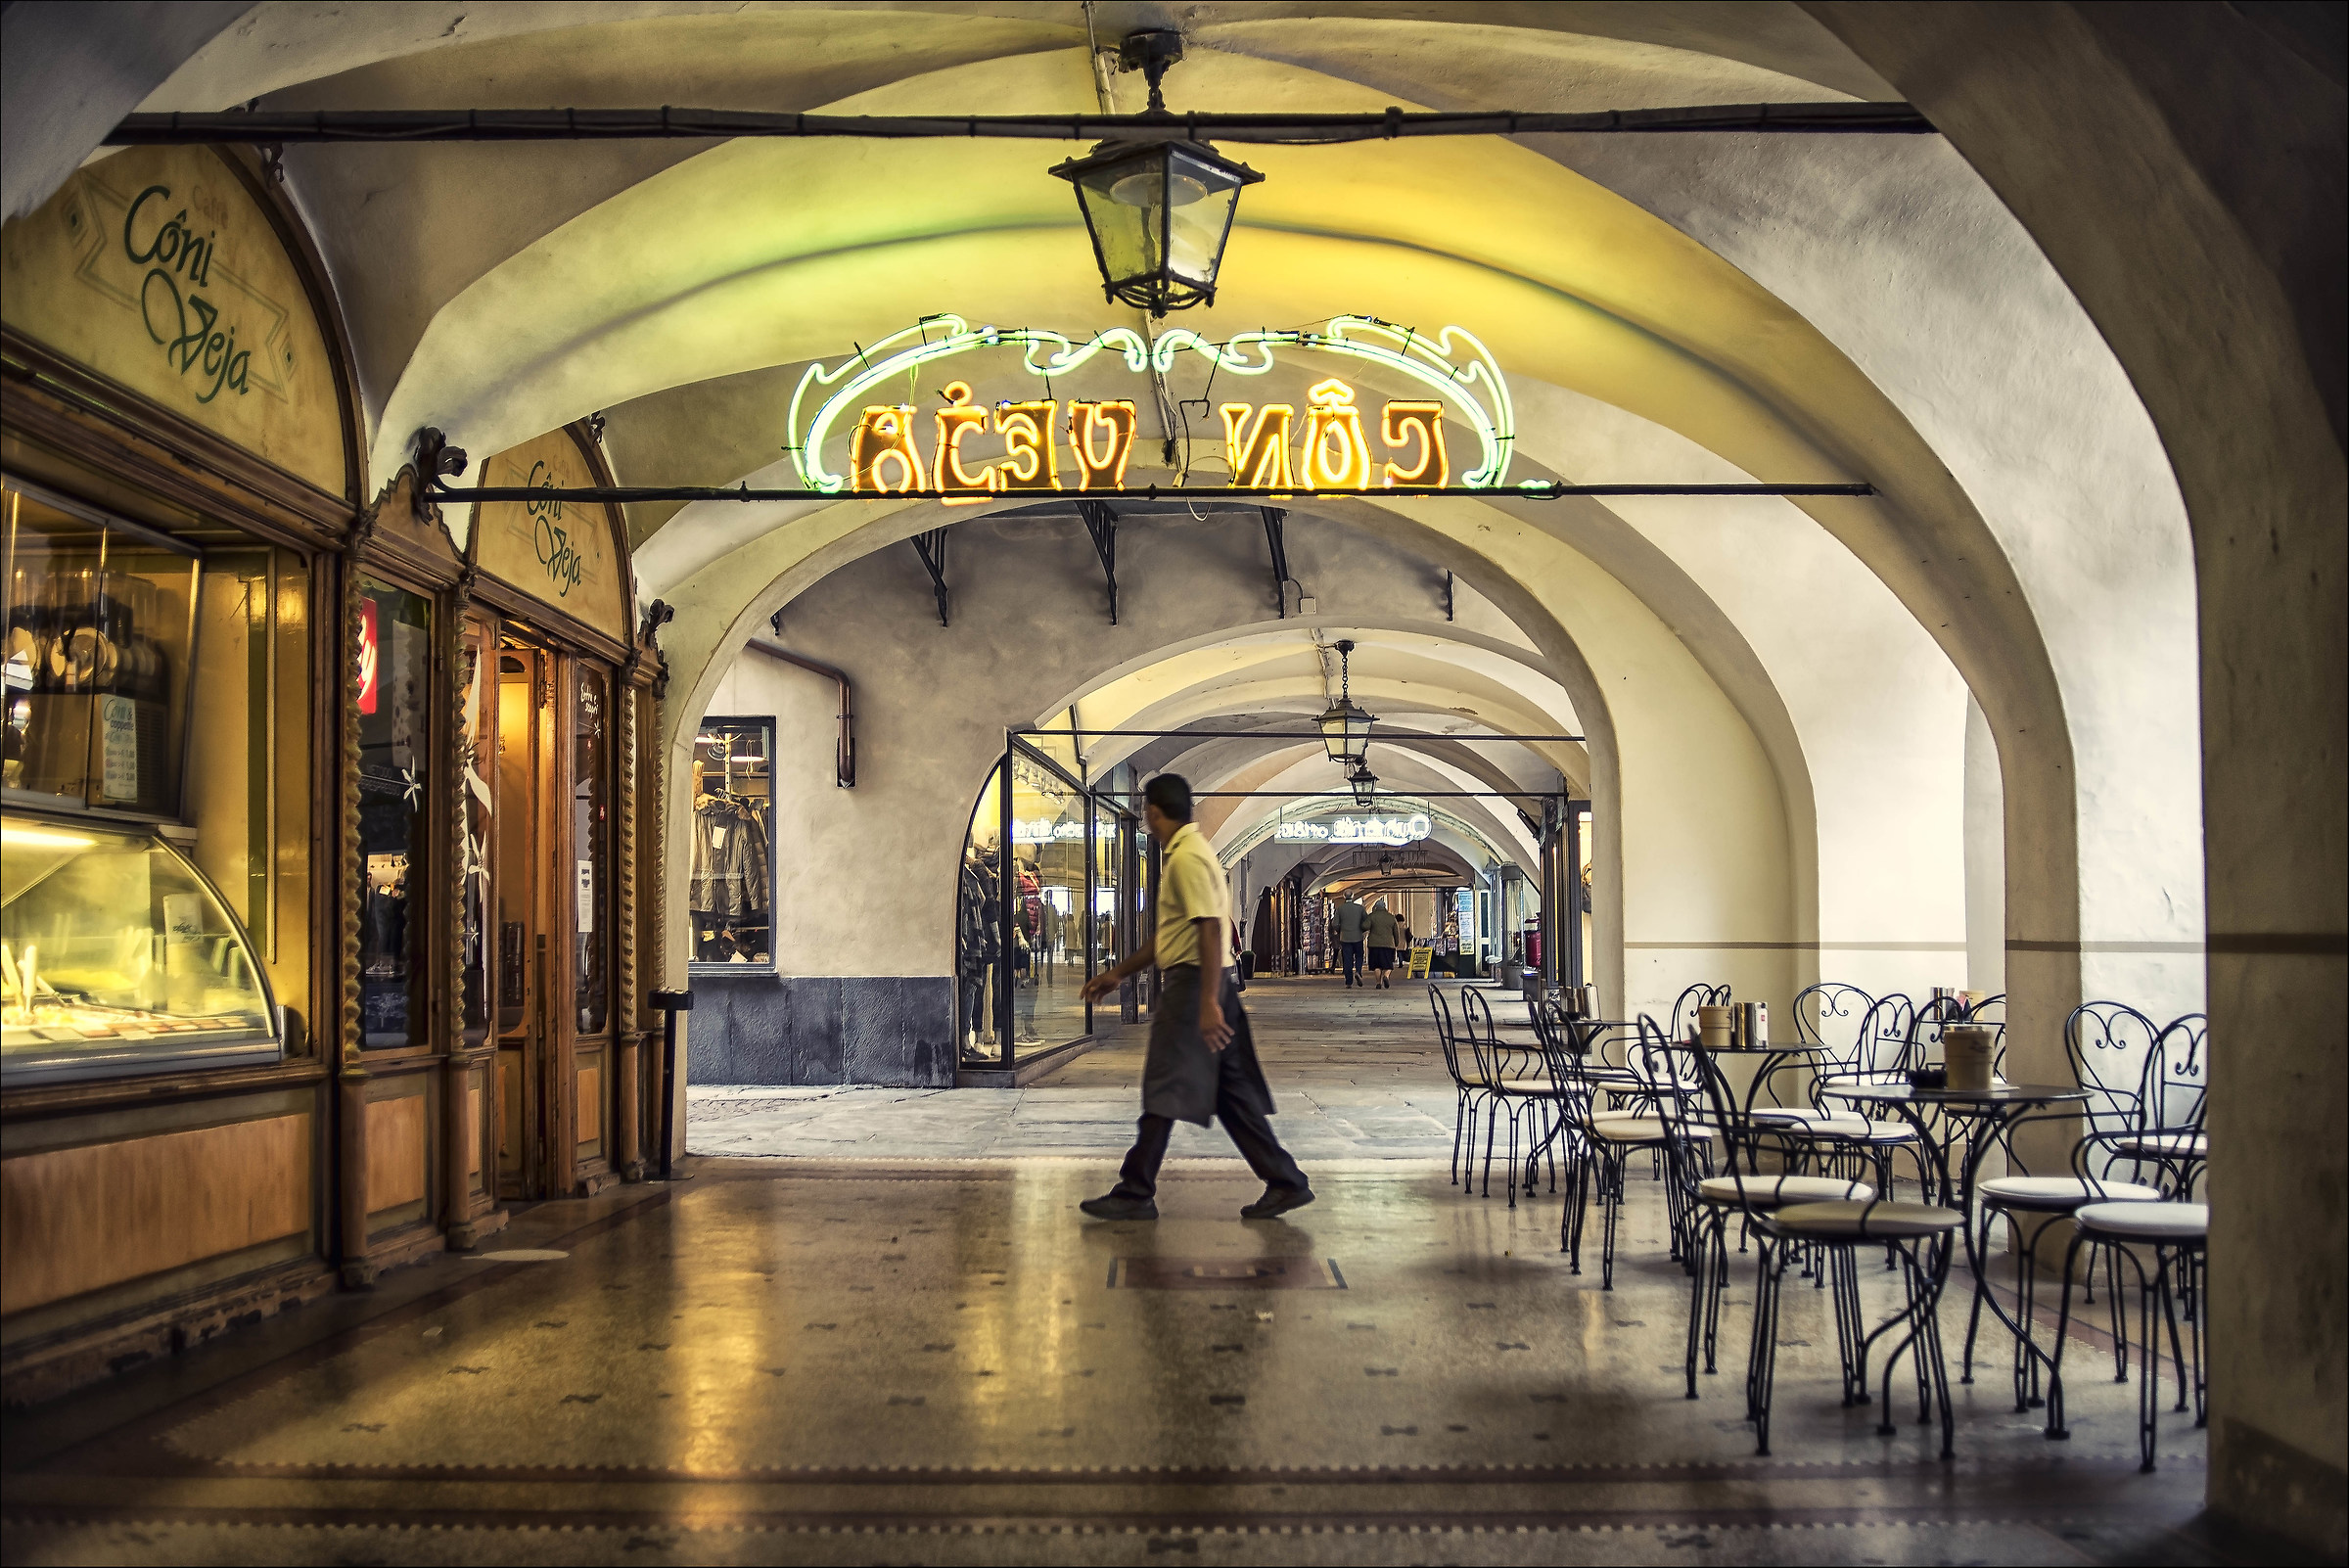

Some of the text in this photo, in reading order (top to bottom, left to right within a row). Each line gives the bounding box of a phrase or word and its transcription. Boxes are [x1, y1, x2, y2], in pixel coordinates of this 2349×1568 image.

[124, 184, 215, 288] Côni
[141, 268, 252, 404] Veja
[534, 514, 582, 598] Veja
